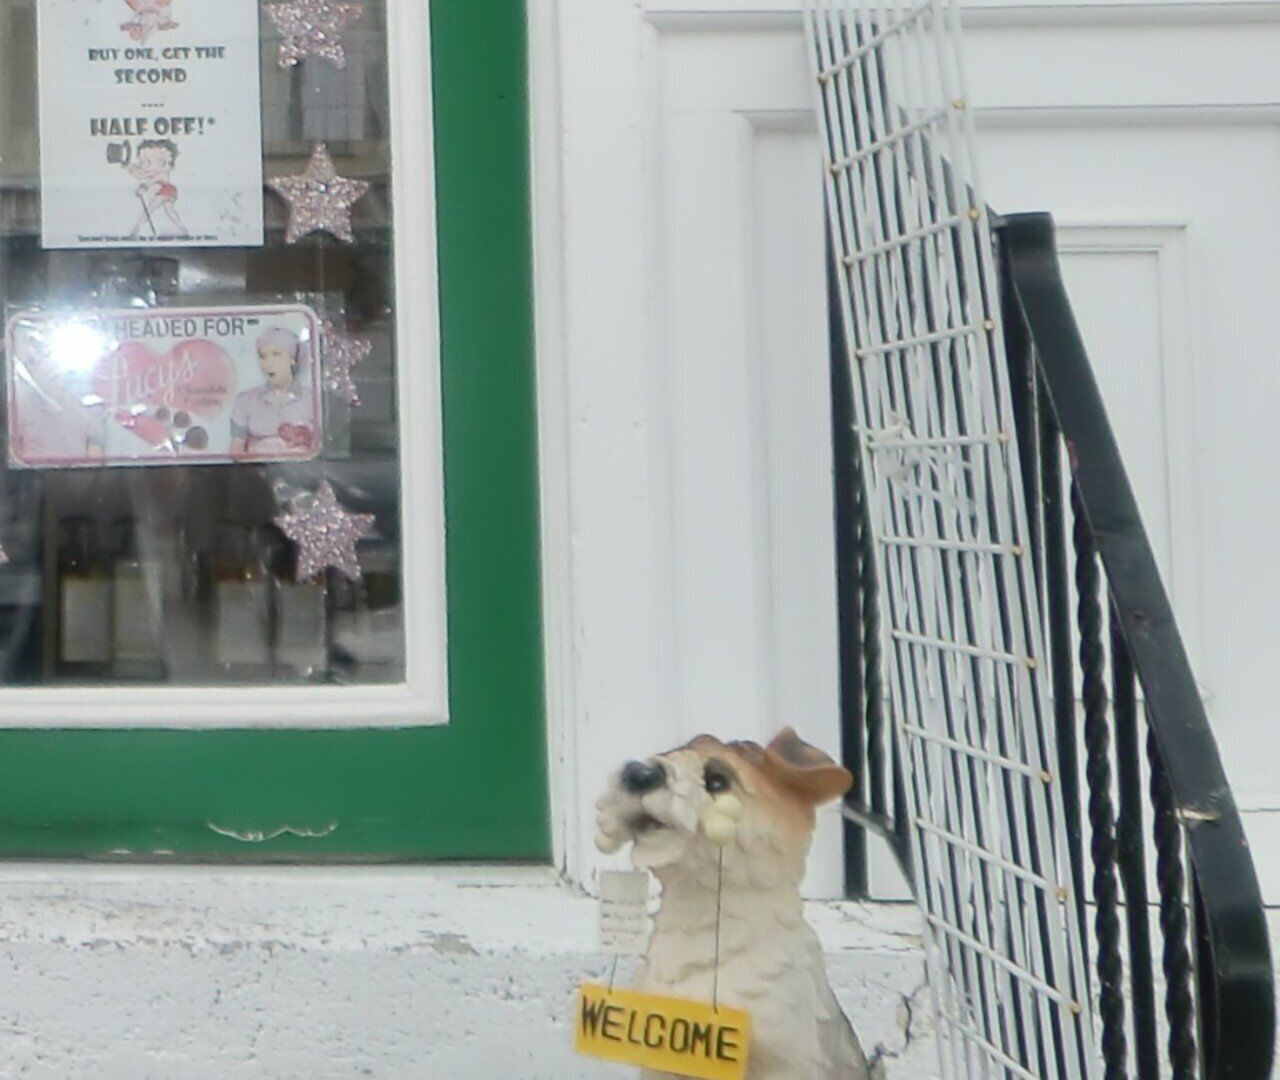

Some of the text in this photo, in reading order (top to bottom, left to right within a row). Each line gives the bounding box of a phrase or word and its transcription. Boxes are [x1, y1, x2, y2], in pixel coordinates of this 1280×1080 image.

[88, 47, 120, 61] BUY
[162, 46, 191, 60] GET
[195, 46, 226, 60] THE
[114, 67, 188, 85] SECOND
[89, 117, 150, 137] HALF
[580, 994, 739, 1063] WELCOME
